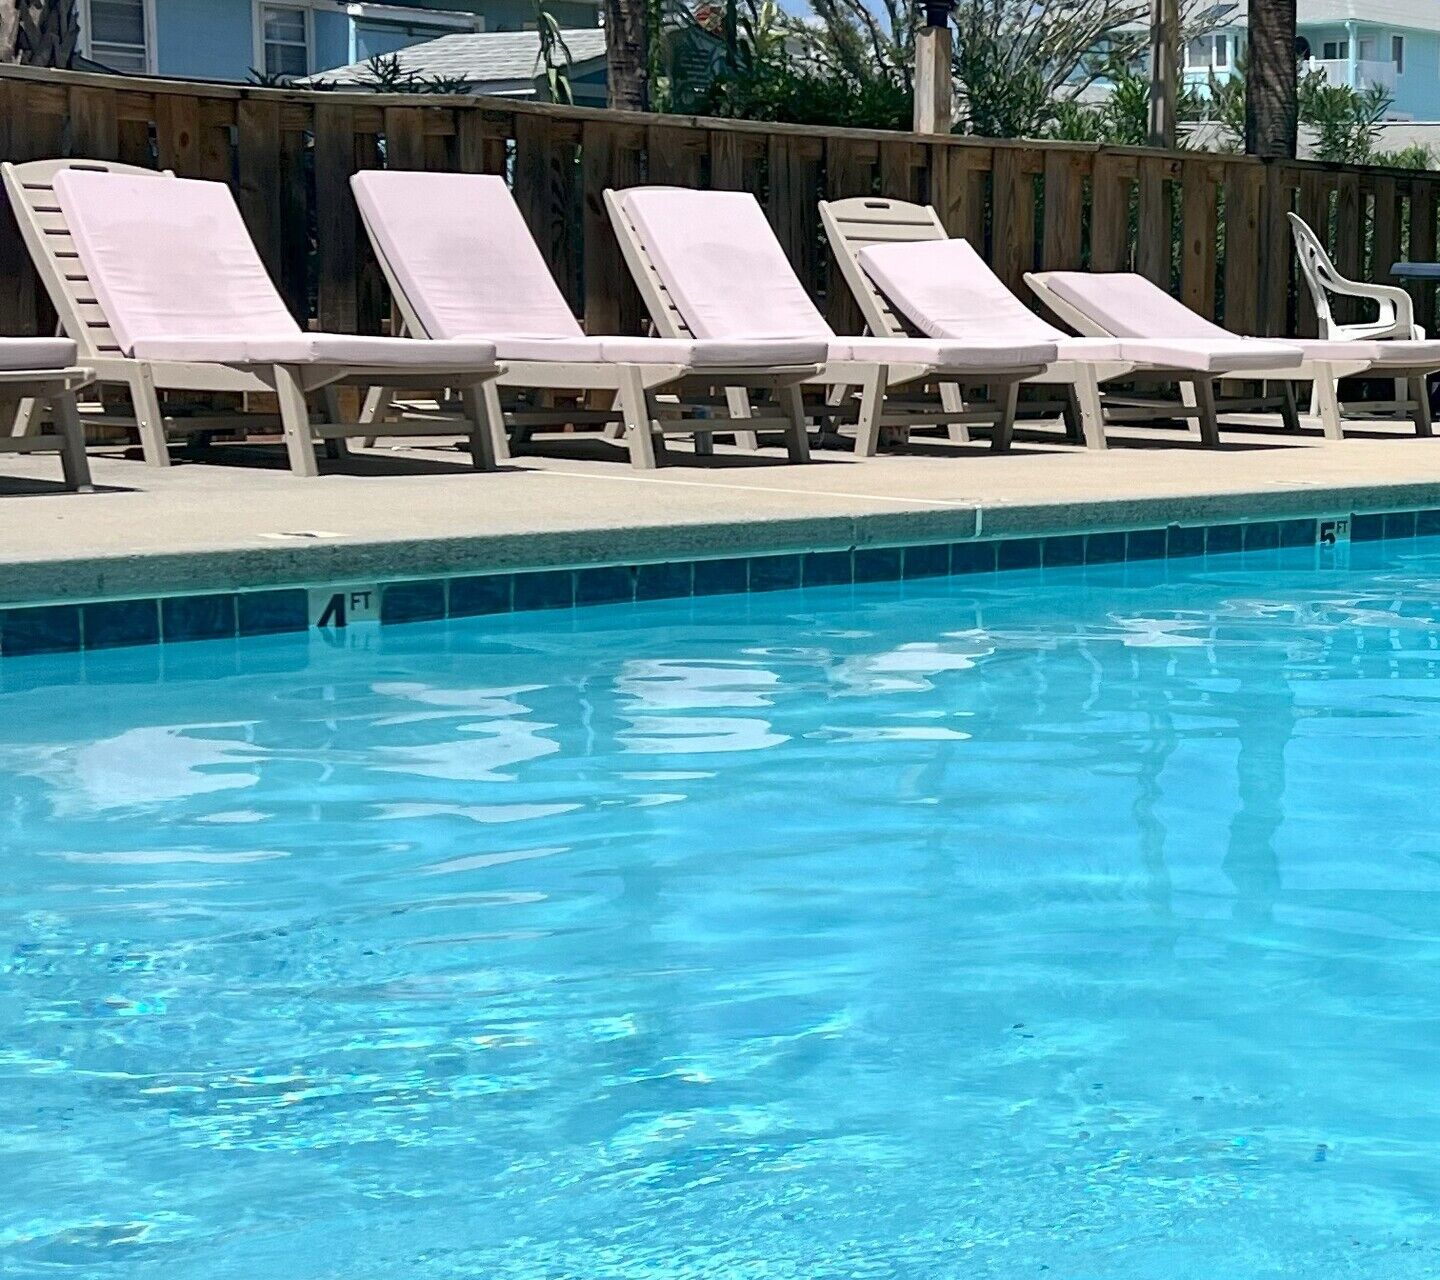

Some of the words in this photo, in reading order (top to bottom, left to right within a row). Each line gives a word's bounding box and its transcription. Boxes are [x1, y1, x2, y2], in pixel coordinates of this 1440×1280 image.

[1320, 522, 1335, 545] 5
[1336, 520, 1348, 534] FT
[317, 593, 347, 627] 4
[350, 590, 371, 611] FT
